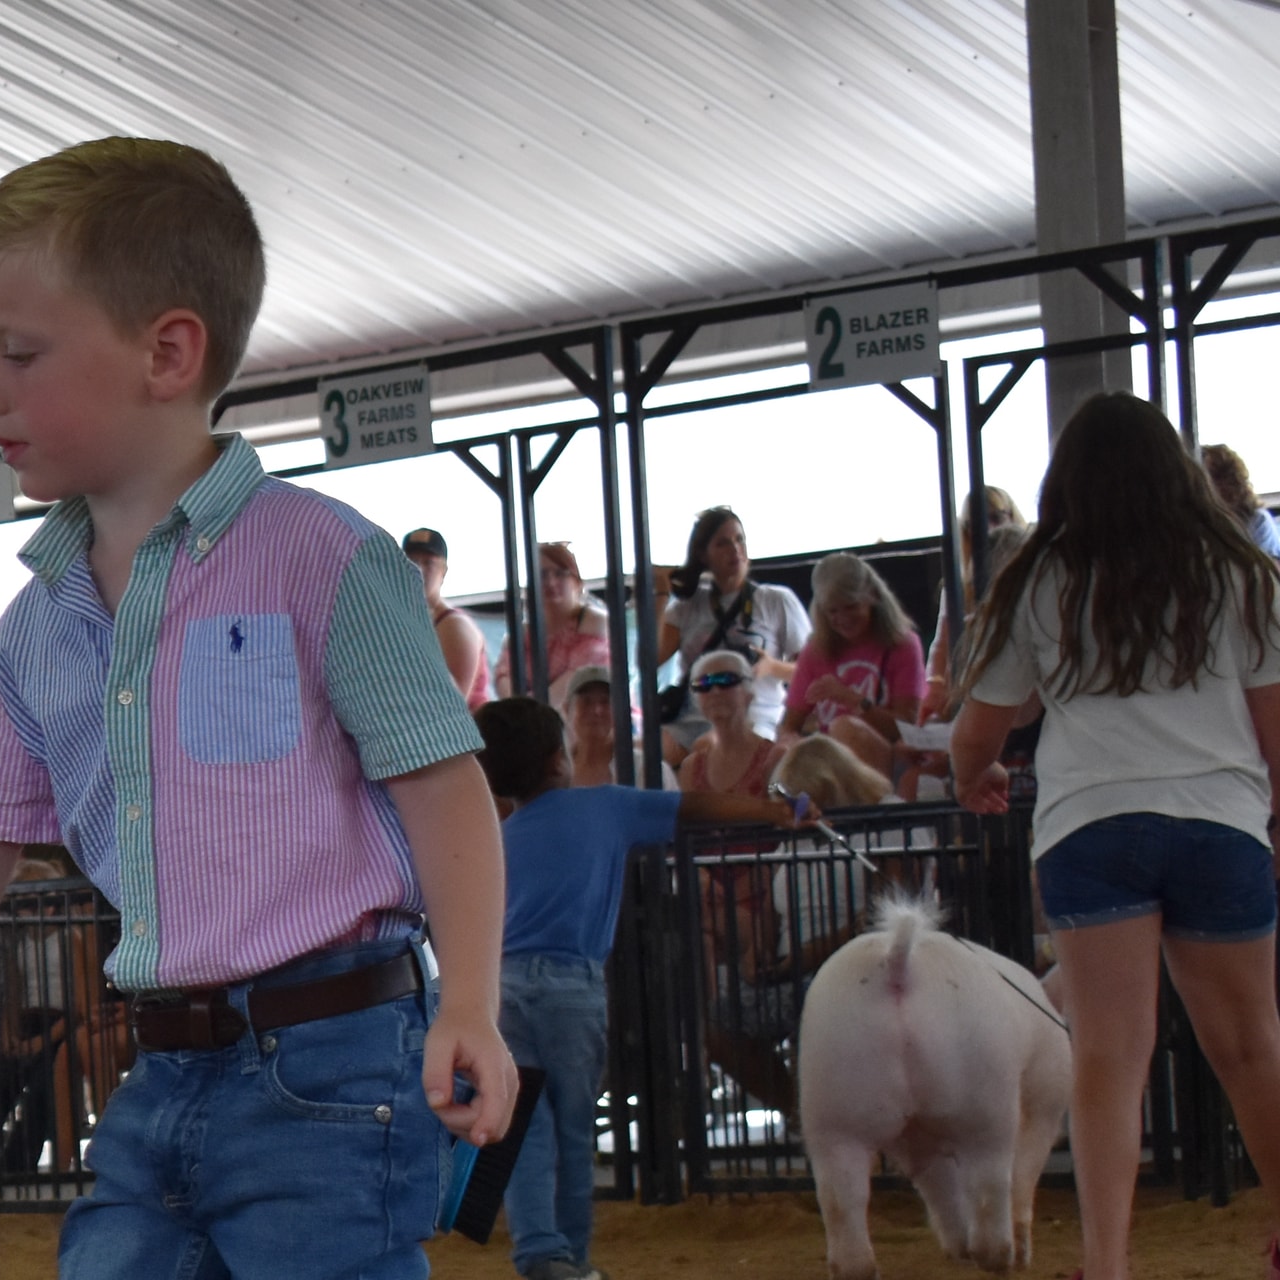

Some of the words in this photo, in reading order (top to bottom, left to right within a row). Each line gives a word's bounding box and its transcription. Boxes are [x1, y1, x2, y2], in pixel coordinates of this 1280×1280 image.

[849, 308, 930, 334] BLAZER
[815, 306, 845, 380] 2
[856, 333, 926, 358] FARMS
[346, 378, 425, 405] OAKVEIW
[324, 388, 350, 458] 3
[357, 403, 416, 426] FARMS
[360, 426, 418, 449] MEATS
